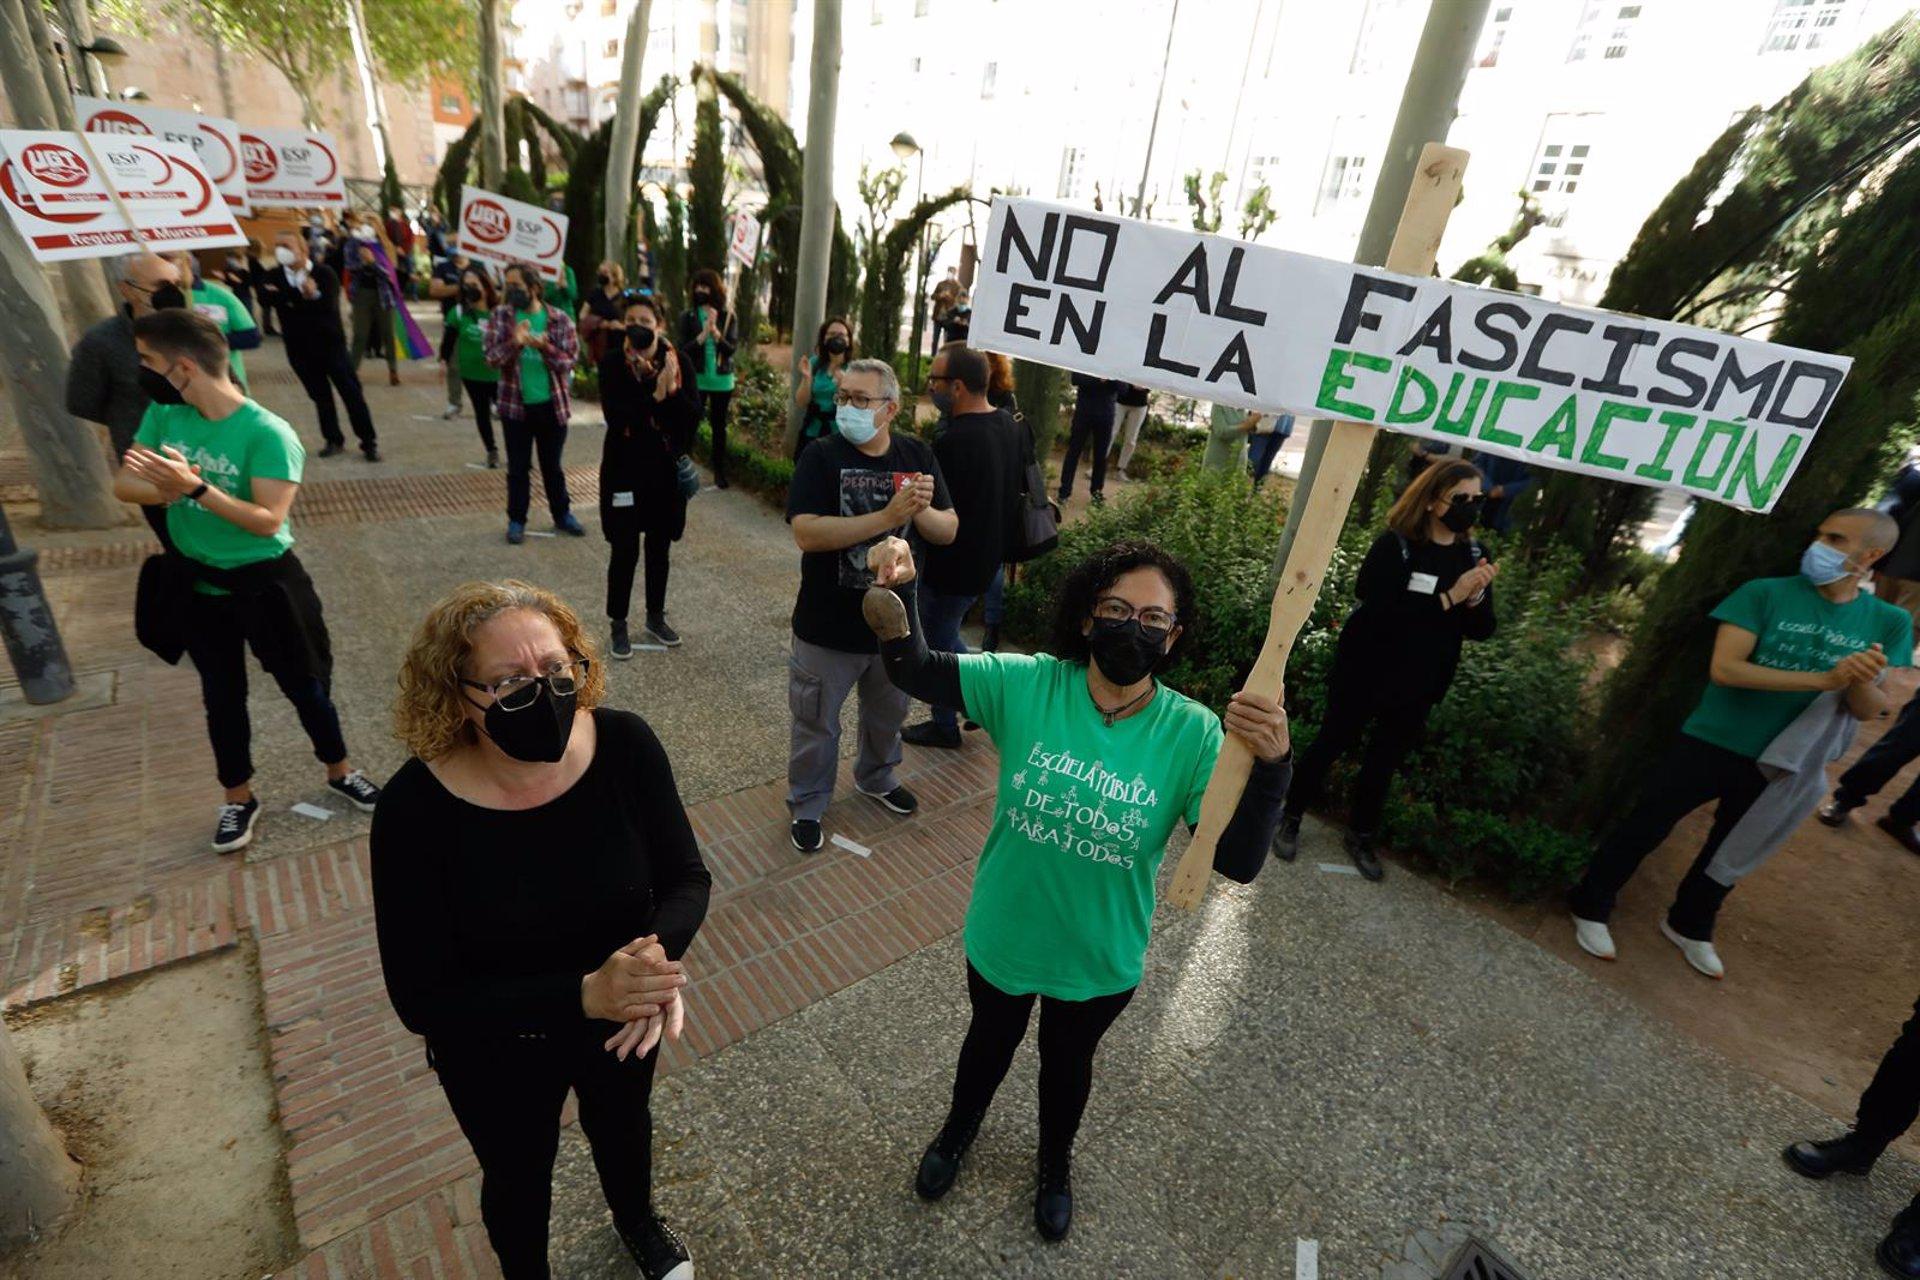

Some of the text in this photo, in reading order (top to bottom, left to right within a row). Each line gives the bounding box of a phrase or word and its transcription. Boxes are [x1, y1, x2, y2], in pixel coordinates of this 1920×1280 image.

[26, 149, 80, 172] UGT
[106, 151, 142, 166] ESP
[67, 228, 127, 248] Región
[153, 226, 208, 241] Murcia
[997, 204, 1844, 430] NO AL FASCISMO
[1004, 283, 1802, 509] EN LA EDUCACIÓN
[1028, 746, 1158, 807] ESCUELA PÚBLICA
[1025, 789, 1056, 814] DE
[1008, 808, 1059, 844] PARA
